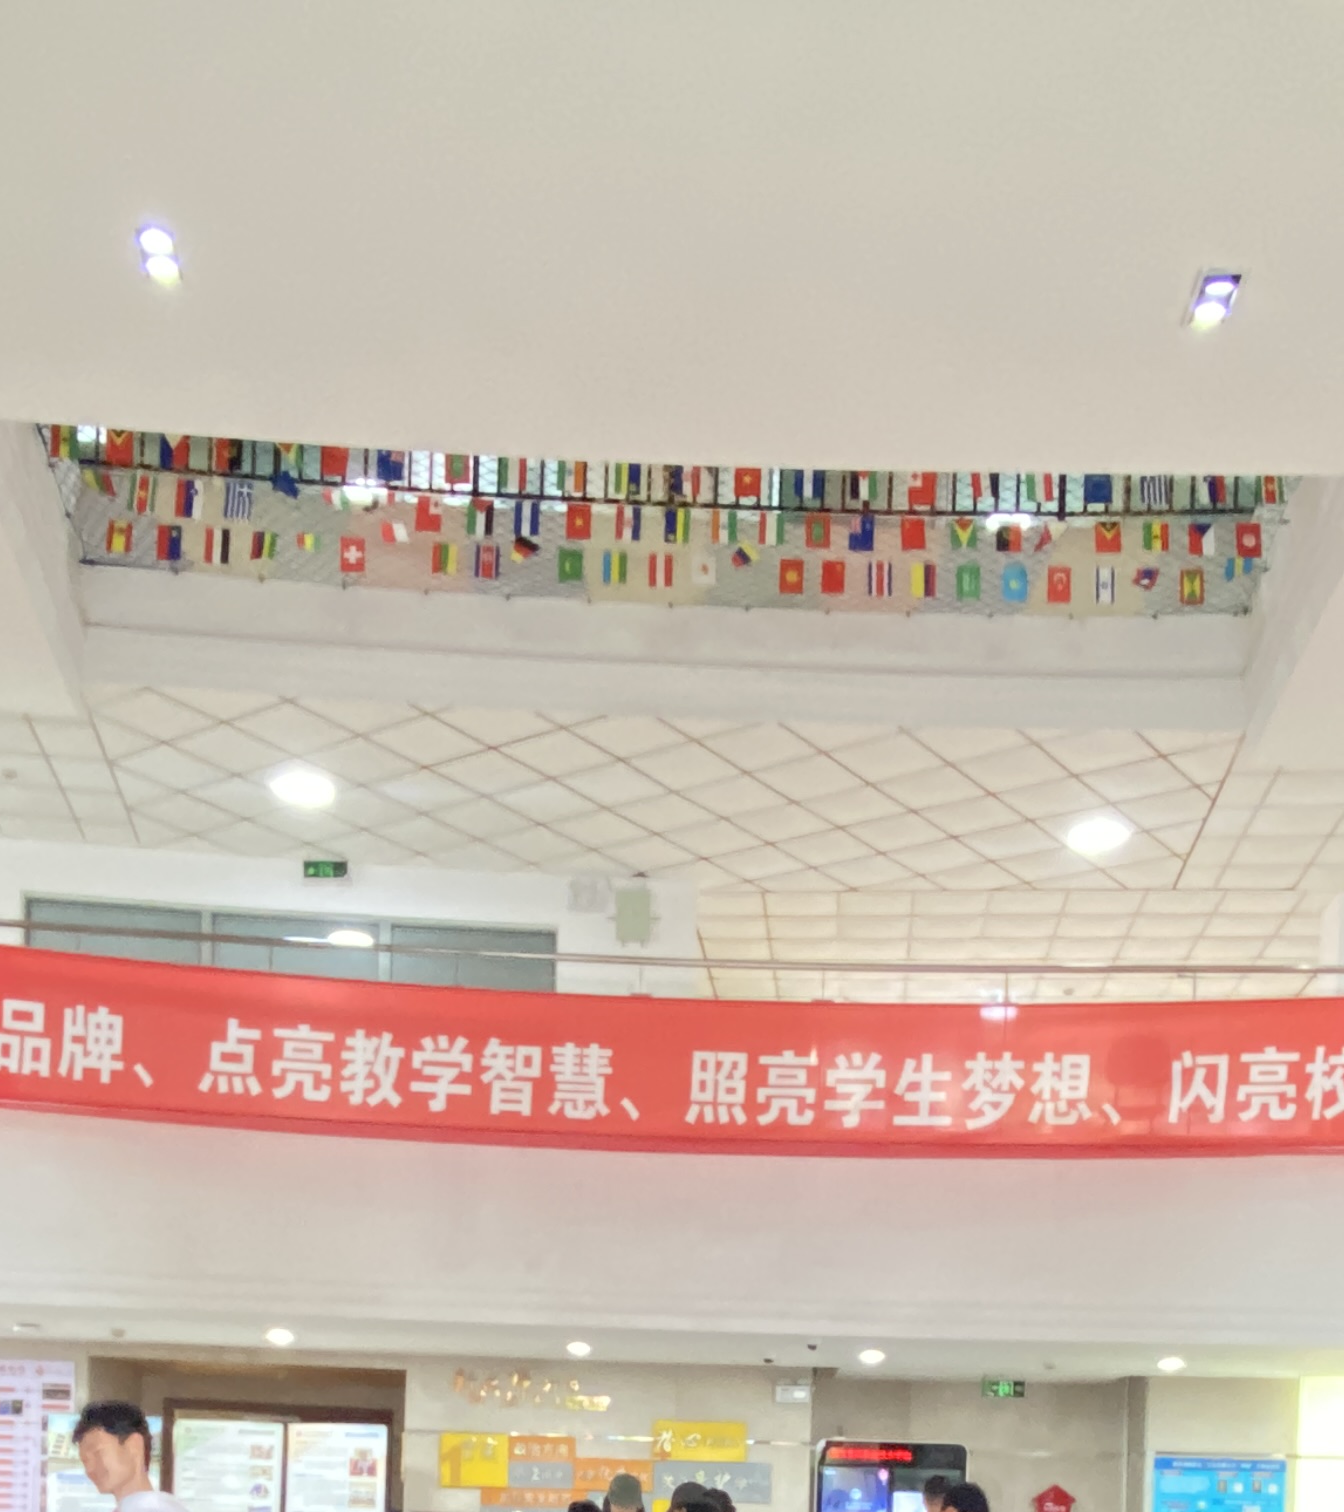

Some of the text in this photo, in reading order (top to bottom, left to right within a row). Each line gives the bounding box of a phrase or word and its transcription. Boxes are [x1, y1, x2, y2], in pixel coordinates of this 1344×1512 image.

[198, 1017, 642, 1123] 点亮教学智慧、
[684, 1049, 1122, 1129] 照亮学生梦想、
